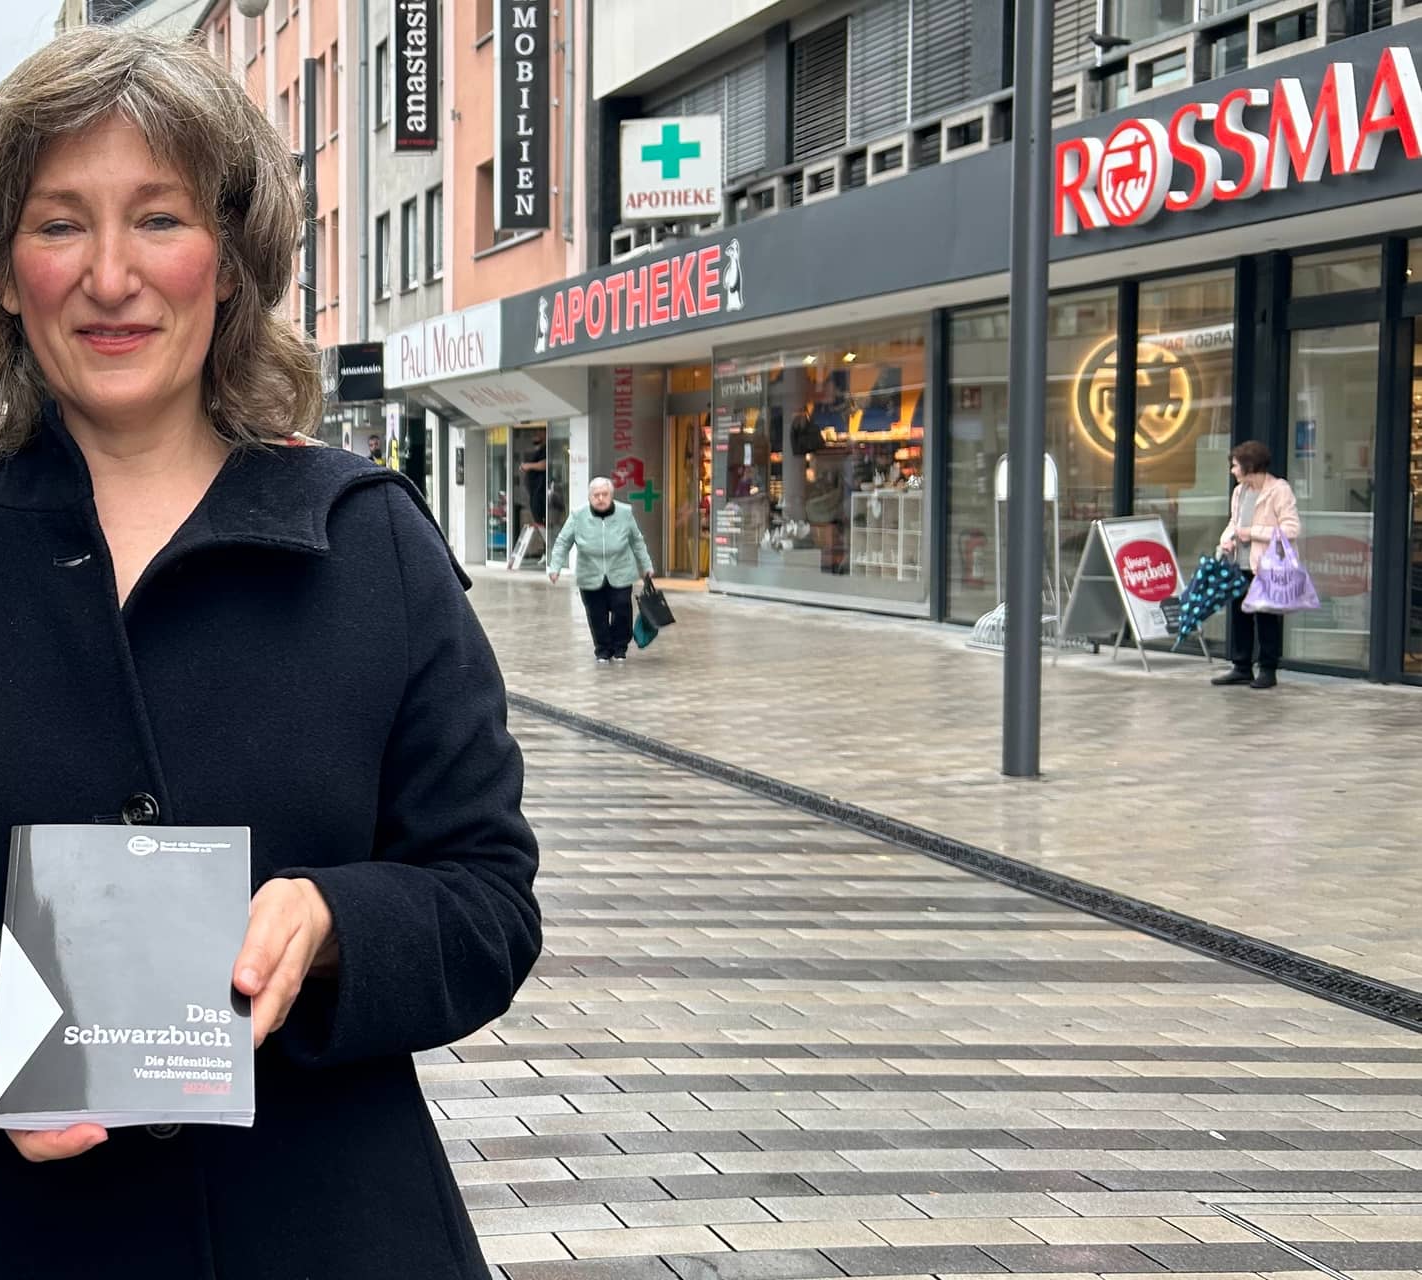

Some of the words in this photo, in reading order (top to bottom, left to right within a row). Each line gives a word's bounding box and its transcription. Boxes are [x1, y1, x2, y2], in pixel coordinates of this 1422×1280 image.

[512, 0, 538, 216] MOBILIEN
[1055, 47, 1422, 236] ROSSMA
[626, 188, 715, 209] APOTHEKE
[549, 245, 721, 348] APOTHEKE
[186, 1004, 232, 1023] Das
[64, 1025, 232, 1047] Schwarzbuch
[145, 1056, 165, 1066] Die
[167, 1056, 232, 1068] öffentliche
[134, 1068, 232, 1082] Verschwendung
